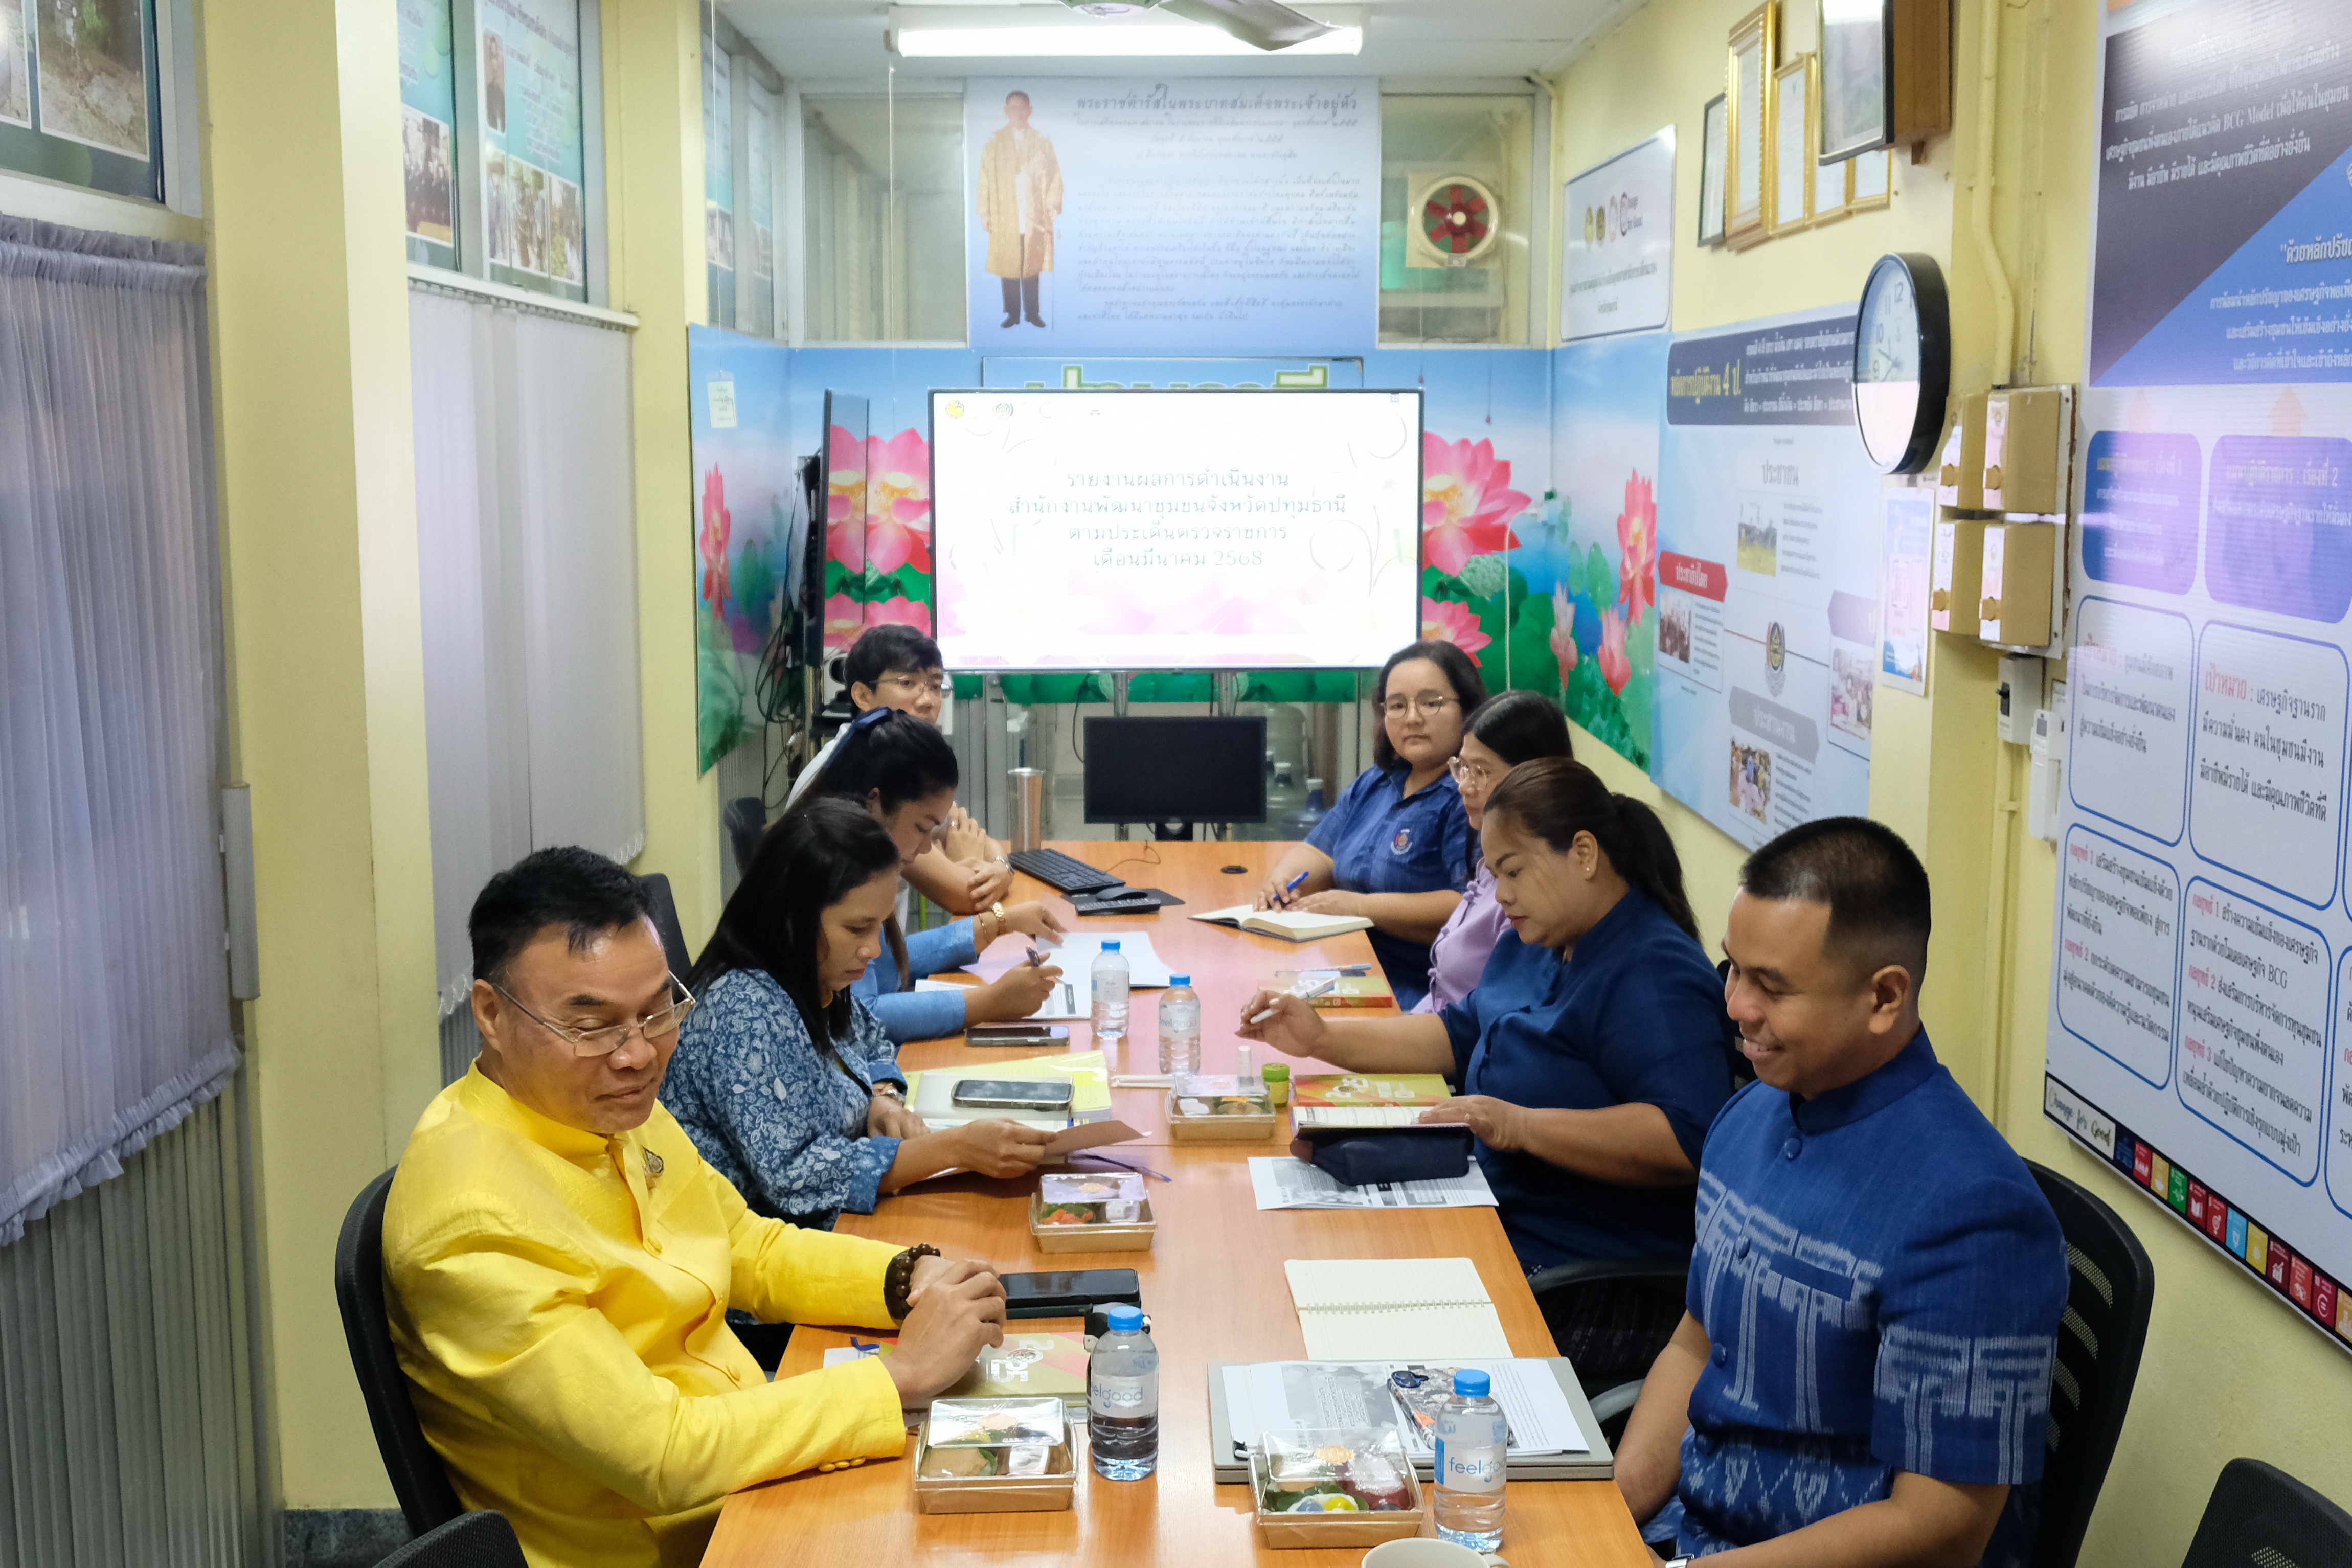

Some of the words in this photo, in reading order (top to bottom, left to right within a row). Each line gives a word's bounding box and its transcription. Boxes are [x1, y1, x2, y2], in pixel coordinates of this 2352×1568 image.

[1077, 83, 1358, 118] พระราชดำรัสในพระบาทสมเด็จพระเจ้าอยู่หัว
[2223, 109, 2244, 132] BCG
[2246, 101, 2274, 127] Model
[1894, 281, 1904, 303] 12
[1723, 361, 1730, 396] 4
[1066, 469, 1289, 488] รายงานผลการดำเนินงาน
[1761, 459, 1800, 486] ประชาชน
[1008, 492, 1347, 519] สำนักงานพัฒนาชุมชนจังหวัดปทุมธานี
[1068, 518, 1287, 541] ตามประเด็นตรวจราชการ
[1093, 548, 1206, 567] เดือนมีนาคม
[1213, 550, 1263, 566] 2568
[2204, 662, 2247, 701] เป้าหมาย
[2256, 686, 2326, 723] เศรษฐกิจฐานราก
[2253, 725, 2325, 768] คนในชุมชนมีงาน
[2268, 964, 2288, 989] BCG
